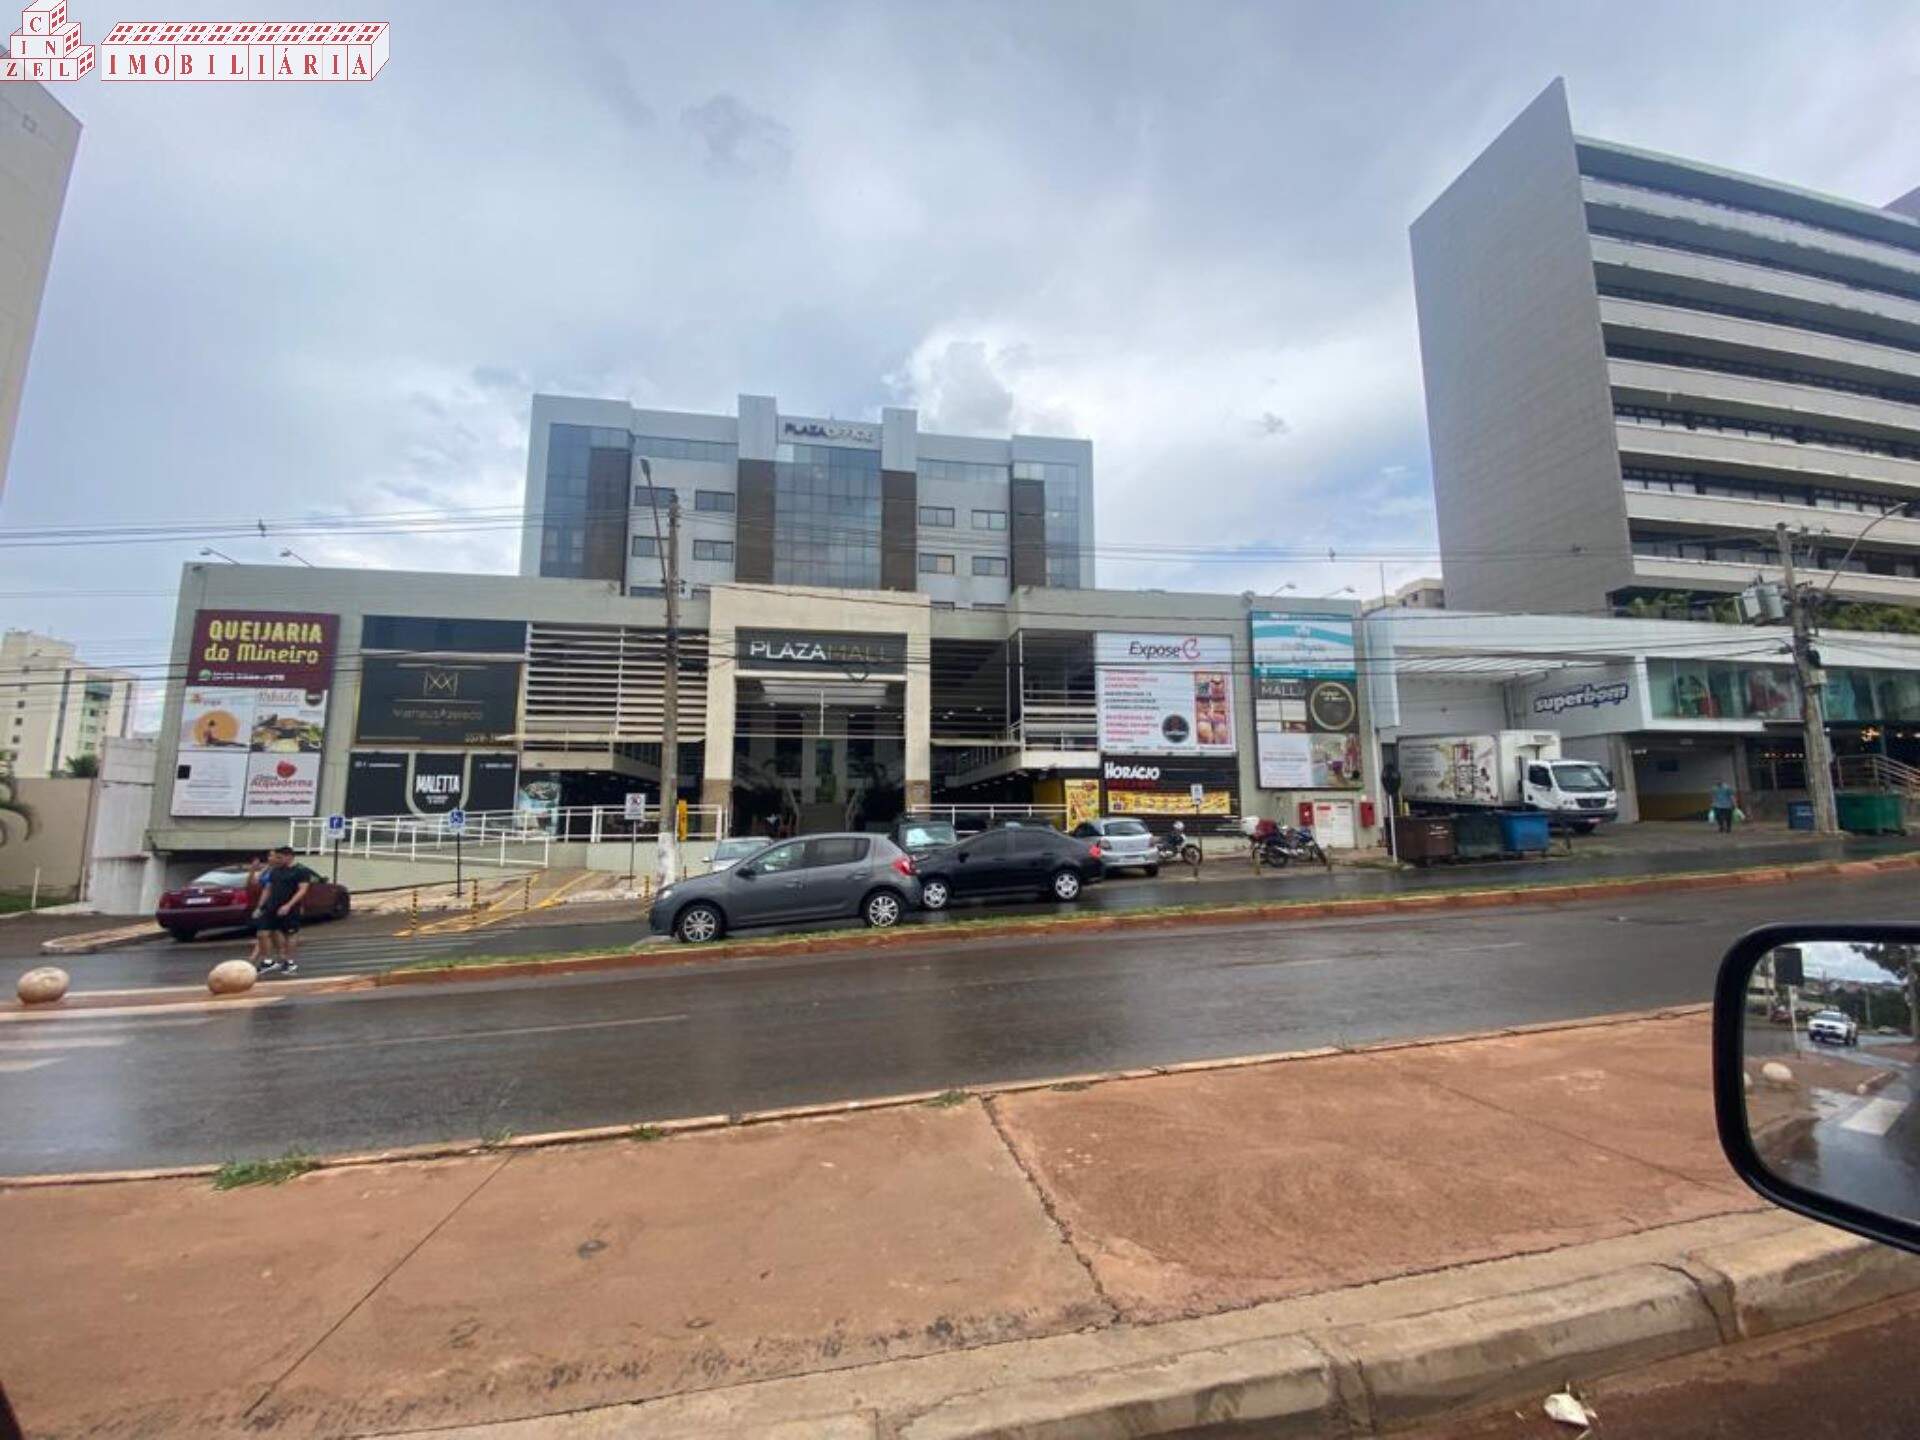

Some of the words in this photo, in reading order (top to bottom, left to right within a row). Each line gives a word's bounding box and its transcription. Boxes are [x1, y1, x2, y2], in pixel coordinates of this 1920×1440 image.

[208, 619, 323, 644] QUEIJARIA
[204, 642, 230, 662] do
[236, 643, 320, 666] Mineiro
[1128, 640, 1181, 661] Expose
[415, 774, 461, 794] MALETTA
